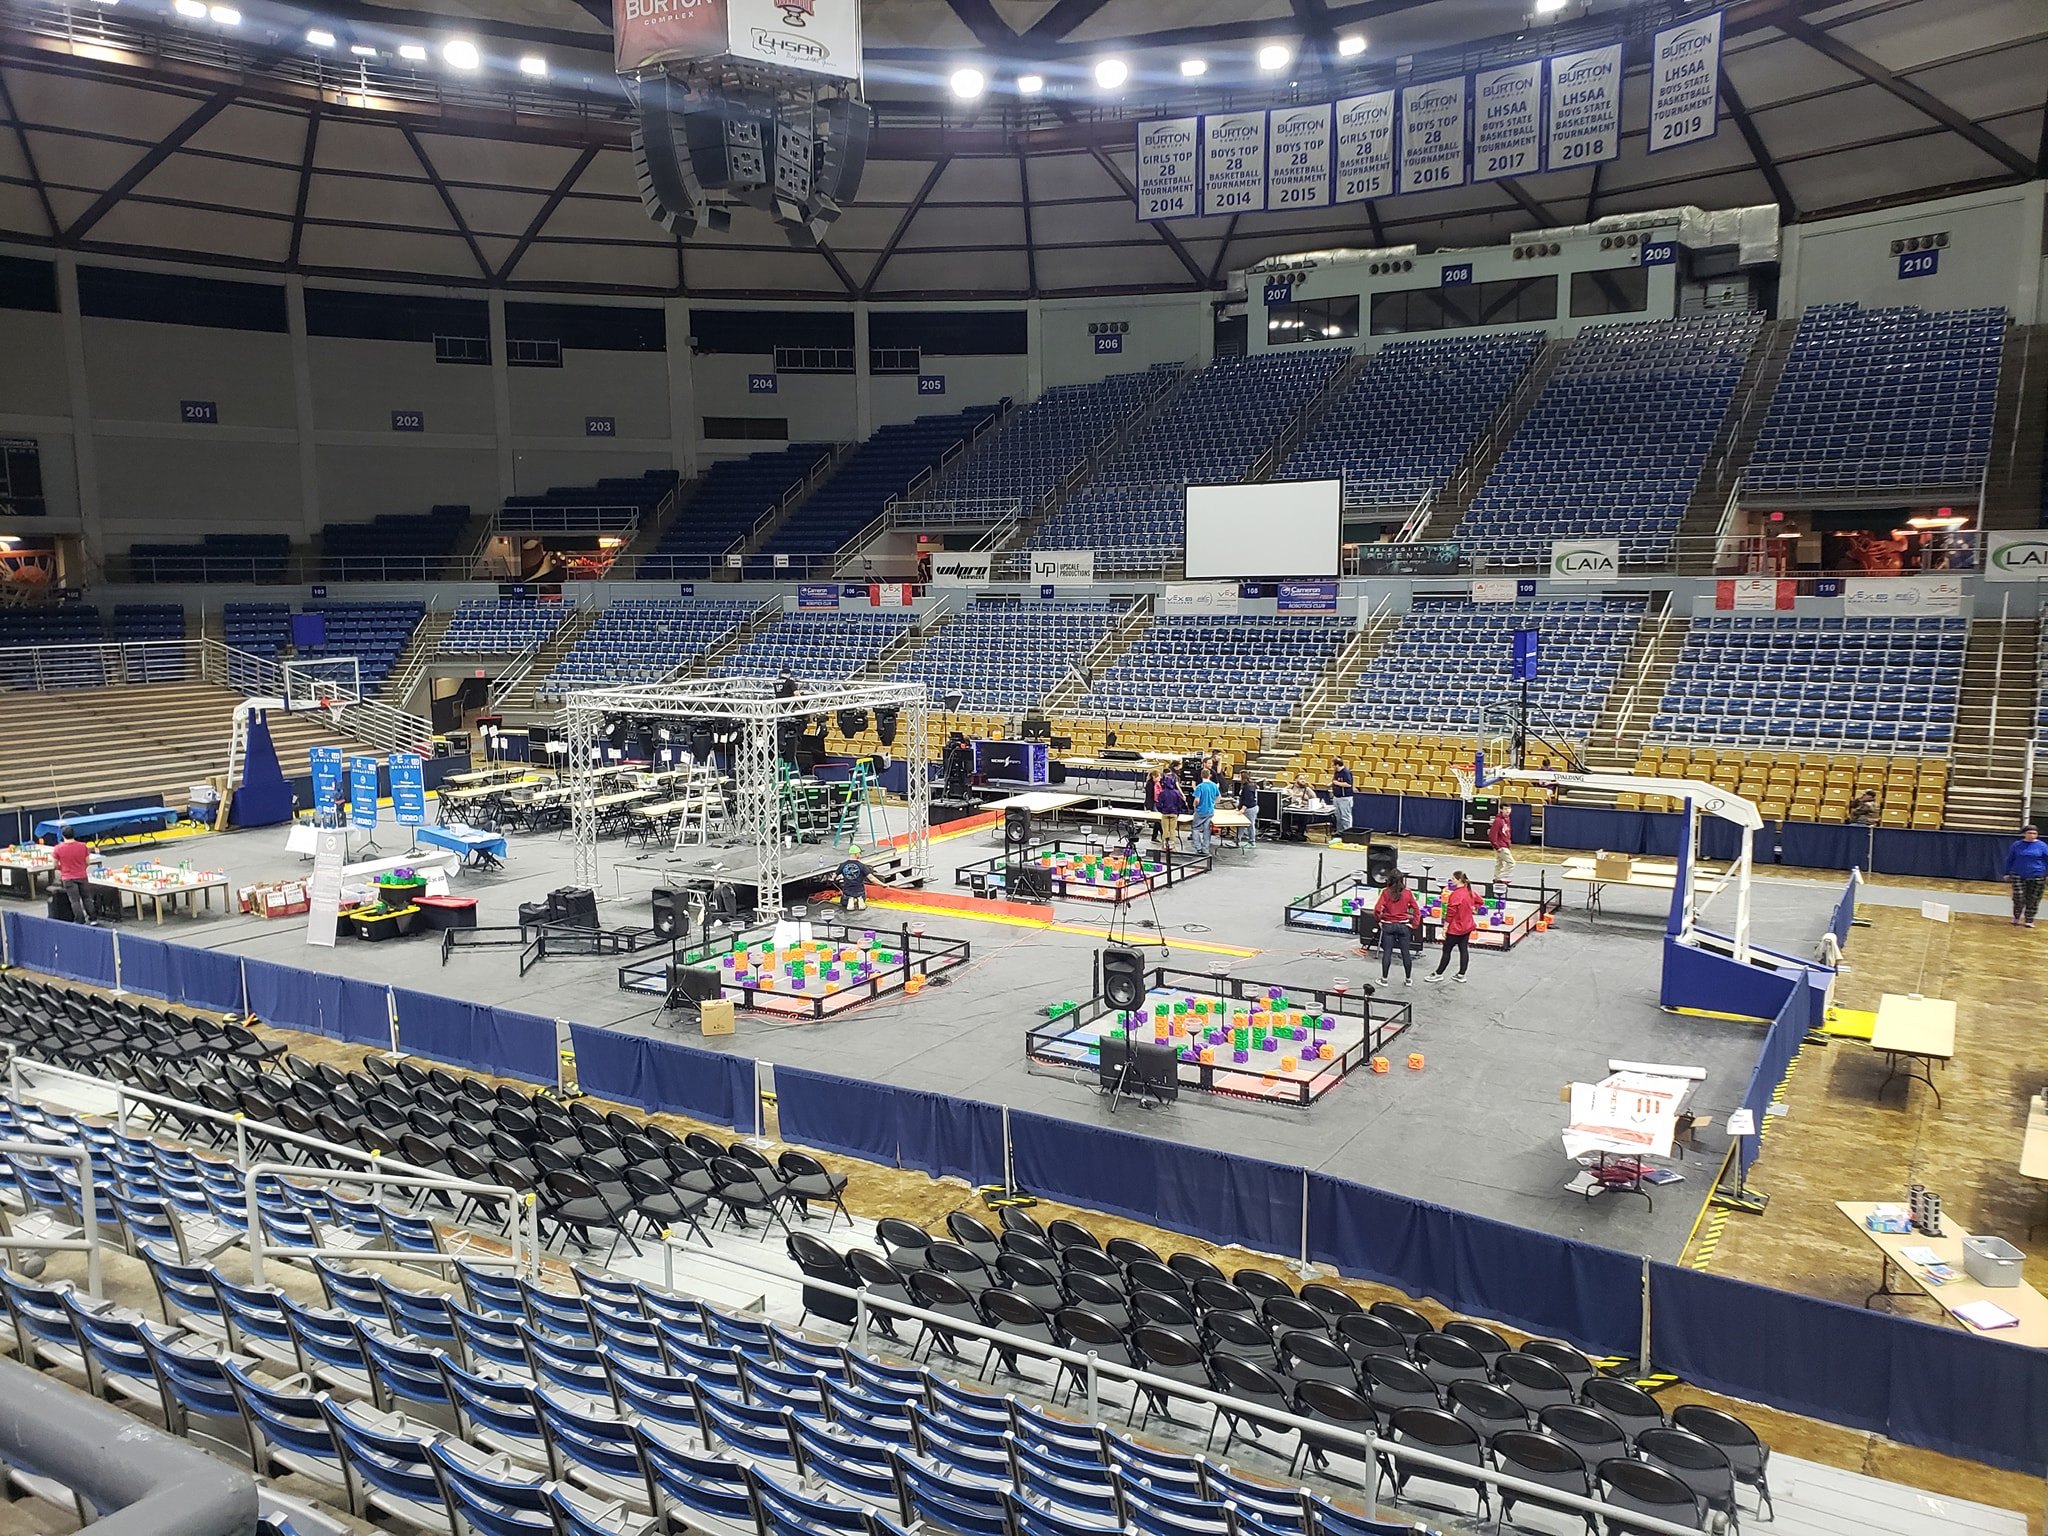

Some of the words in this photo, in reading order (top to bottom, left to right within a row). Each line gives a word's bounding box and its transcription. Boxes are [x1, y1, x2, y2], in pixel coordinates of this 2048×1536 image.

[644, 11, 694, 25] COMPLEX
[758, 36, 822, 56] LHSAA
[1662, 33, 1712, 59] BURTON
[1559, 62, 1612, 84] BURTON
[1665, 59, 1704, 82] LHSAA
[1483, 76, 1533, 97] BURTON
[1660, 82, 1682, 97] BOYS
[1684, 73, 1710, 90] STATE
[1410, 94, 1457, 112] BURTON
[1562, 87, 1604, 106] LHSAA
[1657, 85, 1710, 109] BASKETBALL
[1343, 107, 1387, 124] BURTON
[1487, 100, 1527, 118] LHSAA
[1558, 107, 1581, 119] BOYS
[1584, 100, 1611, 114] STATE
[1654, 96, 1713, 121] TOURNAMENT
[1277, 119, 1324, 134] BURTON
[1409, 120, 1434, 133] BOYS
[1439, 115, 1458, 128] TOP
[1482, 120, 1504, 131] BOYS
[1507, 114, 1532, 127] STATE
[1556, 111, 1613, 130] BASKETBALL
[1212, 126, 1258, 139] BURTON
[1480, 125, 1534, 142] BASKETBALL
[1553, 122, 1616, 141] TOURNAMENT
[1663, 116, 1701, 140] 2019
[1145, 132, 1190, 146] BURTON
[1340, 131, 1367, 145] GIRLS
[1370, 128, 1389, 140] TOP
[1425, 130, 1441, 144] 28
[1276, 142, 1301, 153] BOYS
[1304, 140, 1324, 150] TOP
[1356, 142, 1372, 156] 28
[1407, 142, 1458, 157] BASKETBALL
[1477, 135, 1537, 153] TOURNAMENT
[1563, 139, 1604, 160] 2018
[1143, 154, 1170, 164] GIRLS
[1172, 152, 1192, 162] TOP
[1211, 147, 1236, 158] BOYS
[1239, 146, 1258, 156] TOP
[1405, 151, 1461, 167] TOURNAMENT
[1226, 158, 1242, 170] 28
[1291, 153, 1308, 166] 28
[1340, 153, 1389, 168] BASKETBALL
[1488, 152, 1525, 172] 2017
[1160, 164, 1175, 176] 28
[1210, 170, 1259, 181] BASKETBALL
[1274, 165, 1324, 176] BASKETBALL
[1413, 166, 1450, 184] 2016
[1143, 176, 1191, 187] BASKETBALL
[1206, 178, 1261, 190] TOURNAMENT
[1271, 174, 1326, 185] TOURNAMENT
[1347, 177, 1380, 195] 2015
[1141, 184, 1193, 196] TOURNAMENT
[1280, 188, 1316, 202] 2015
[1150, 198, 1184, 212] 2014
[1216, 192, 1251, 207] 2014
[1645, 246, 1671, 262] 209
[1904, 256, 1932, 273] 210
[1445, 269, 1468, 282] 208
[1267, 288, 1287, 300] 207
[1098, 339, 1118, 350] 206
[752, 379, 773, 389] 204
[921, 380, 941, 390] 205
[186, 406, 211, 418] 201
[396, 416, 419, 427] 202
[590, 421, 611, 433] 203
[1566, 558, 1613, 570] LAIA
[2006, 551, 2048, 565] LAI
[1740, 581, 1772, 591] VEX
[1819, 584, 1835, 592] 110
[1929, 584, 1958, 593] VEX
[1554, 774, 1584, 782] SPALDING
